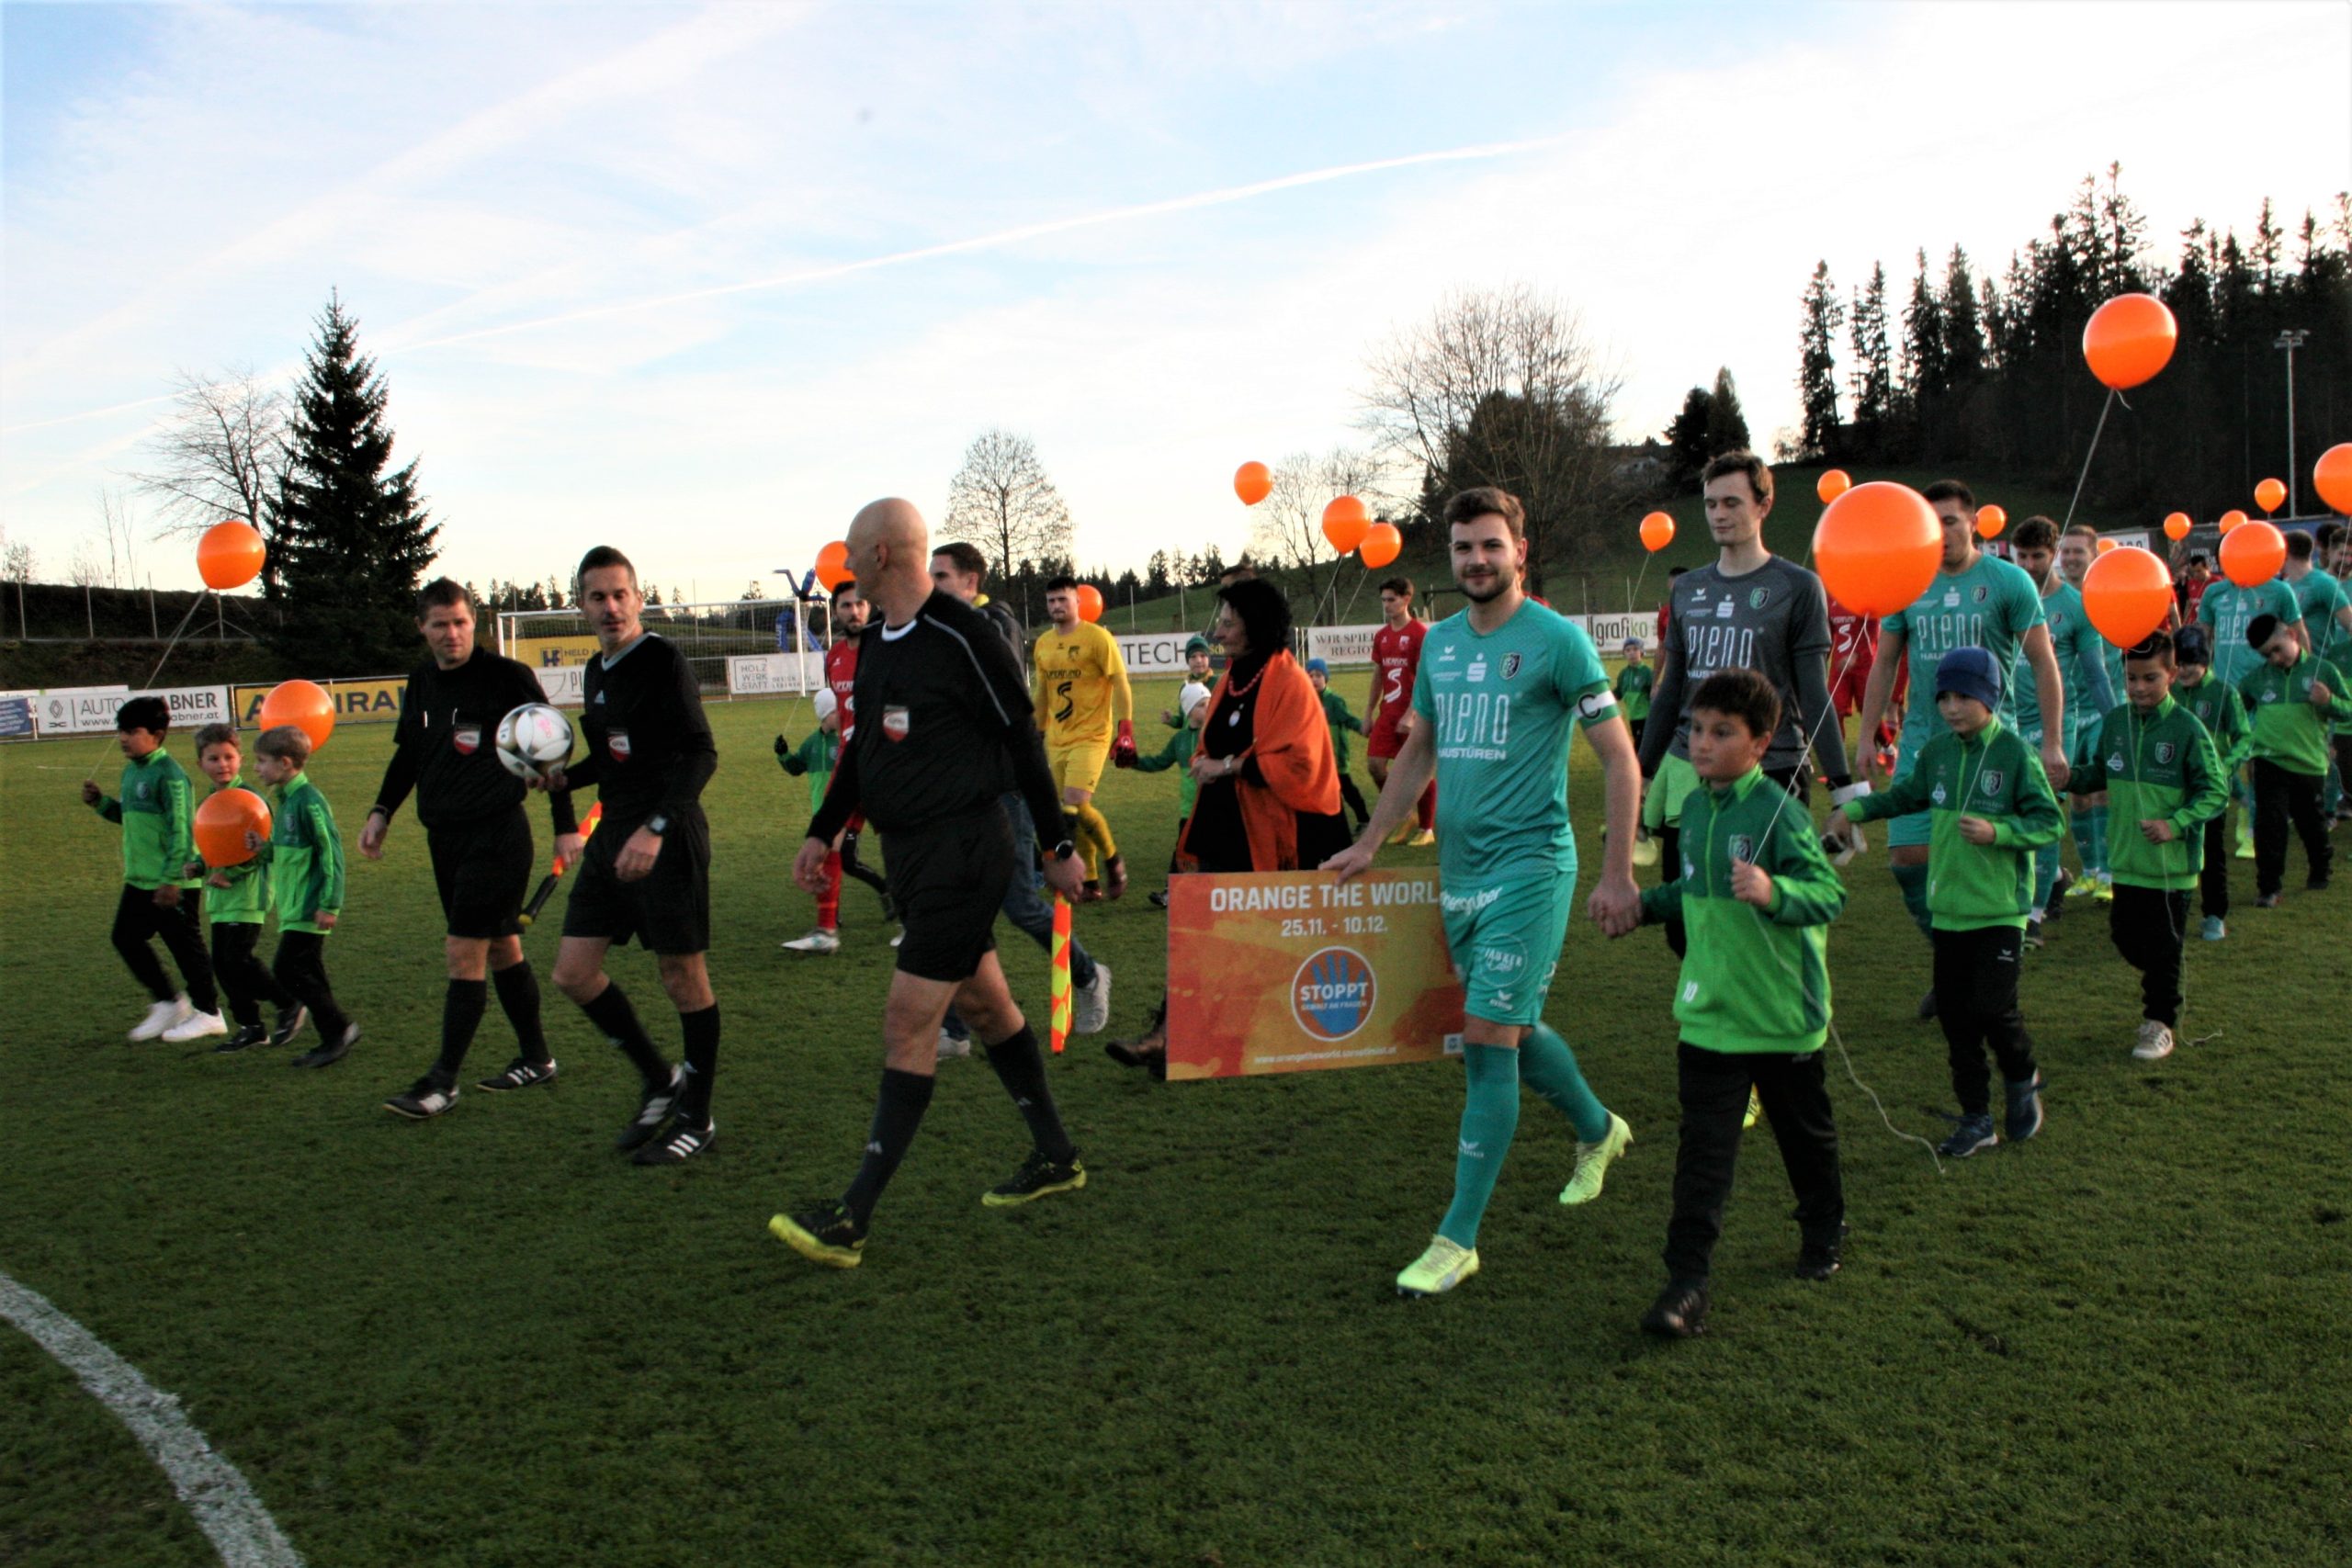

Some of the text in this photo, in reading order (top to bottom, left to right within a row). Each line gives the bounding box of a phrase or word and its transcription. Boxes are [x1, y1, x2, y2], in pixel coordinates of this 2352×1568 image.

[1316, 632, 1374, 644] WIR SPIEL
[1126, 640, 1186, 665] TECH
[1330, 646, 1372, 657] REGIO
[741, 664, 766, 672] HOLZ
[1578, 694, 1601, 719] C
[1210, 880, 1440, 912] ORANGE THE WORL
[1281, 919, 1328, 937] 25.11.
[1342, 916, 1388, 934] 10.12.
[1300, 982, 1369, 1001] STOPPT
